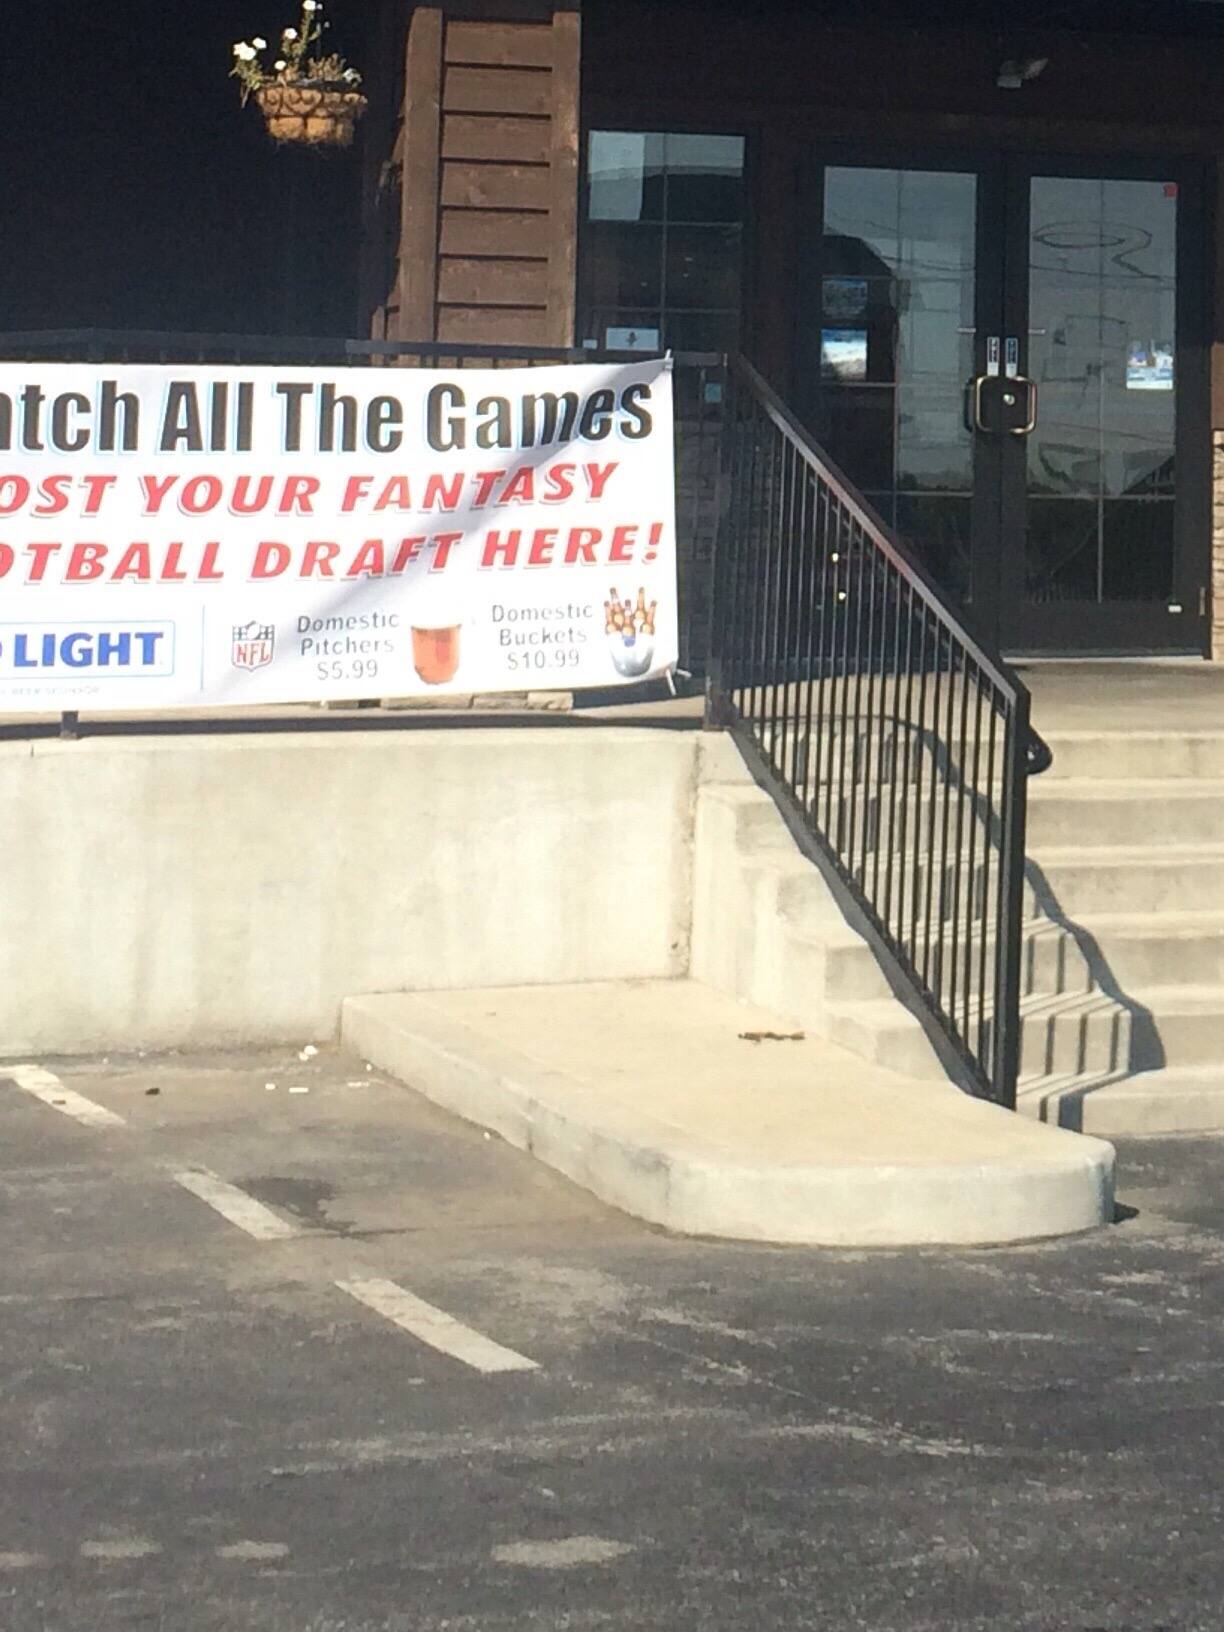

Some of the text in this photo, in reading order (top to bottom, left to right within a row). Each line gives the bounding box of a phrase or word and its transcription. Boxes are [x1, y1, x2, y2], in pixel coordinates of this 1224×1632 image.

[160, 381, 255, 452] All
[276, 382, 404, 453] The
[426, 382, 653, 453] Games
[142, 475, 320, 514] YOUR
[341, 462, 619, 512] FANTASY
[250, 532, 463, 580] DRAFT
[481, 522, 663, 567] HERE!
[297, 612, 399, 633] Domestic
[492, 603, 593, 623] Domestic
[301, 636, 395, 656] Pitchers
[500, 626, 587, 646] Buckets
[14, 632, 163, 667] LIGHT
[236, 643, 270, 666] NFL
